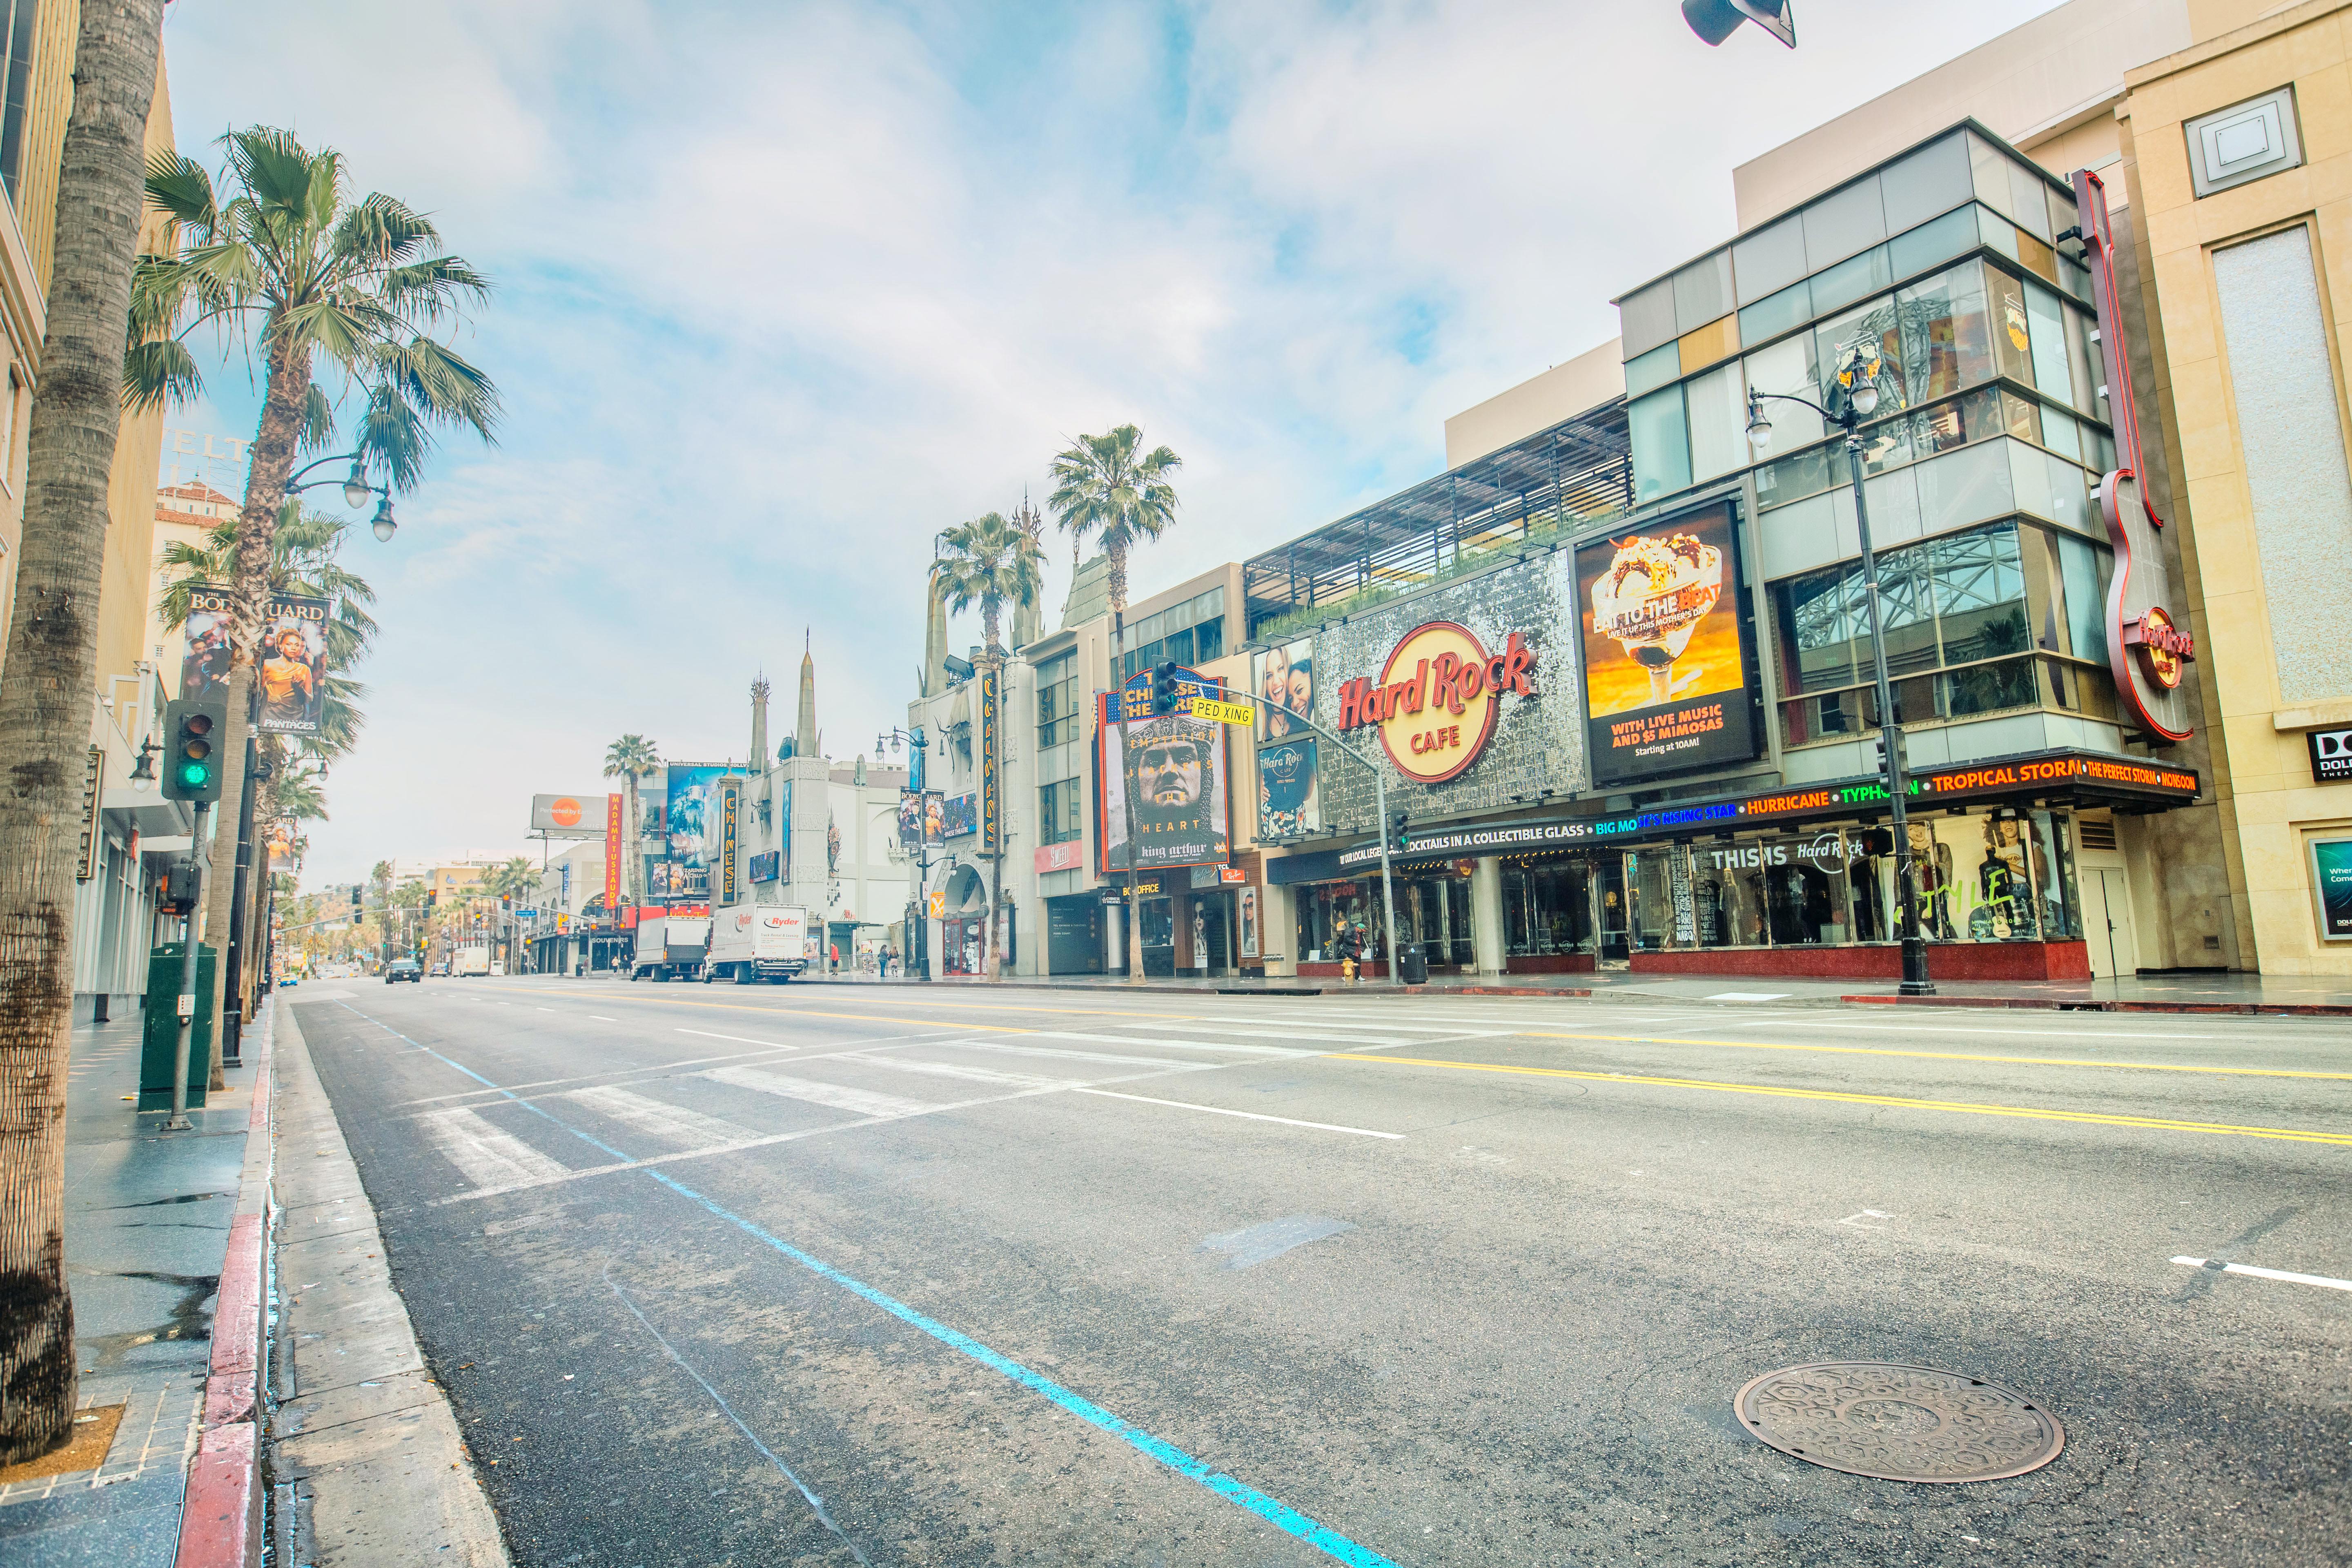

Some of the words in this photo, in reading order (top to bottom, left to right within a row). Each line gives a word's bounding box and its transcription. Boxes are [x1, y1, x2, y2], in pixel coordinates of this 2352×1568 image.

[1593, 613, 1619, 634] EAT
[1621, 607, 1644, 625] TO
[1646, 595, 1677, 619] THE
[1679, 583, 1722, 610] BEAT
[1607, 628, 1621, 639] LIVE
[1621, 627, 1628, 635] IT
[1629, 625, 1638, 634] UP
[1639, 621, 1655, 631] THIS
[1656, 610, 1692, 627] MOTHER'S
[1693, 607, 1708, 617] DAY
[1338, 658, 1430, 731] Hard
[1432, 631, 1539, 715] Rock
[1198, 702, 1219, 717] PED
[1224, 707, 1250, 722] XING
[1611, 719, 1645, 735] WITH
[1648, 713, 1675, 728] LIVE
[1679, 704, 1722, 723] MUSIC
[263, 719, 316, 730] PANTAGES
[1613, 733, 1640, 748] AND
[1643, 730, 1655, 744] $5
[1659, 717, 1723, 739] MIMOSAS
[1130, 730, 1216, 748] EMPTATION
[1410, 725, 1461, 754] CAFE
[1635, 746, 1665, 756] Starting
[1666, 742, 1674, 751] at
[1675, 737, 1699, 748] 10AM!
[1263, 755, 1285, 769] Hard
[2087, 761, 2103, 778] THE
[2103, 763, 2133, 782] PERFECT
[2133, 767, 2157, 785] STORM
[1933, 767, 2017, 793] TROPICAL
[2020, 760, 2082, 781] STORM
[2162, 775, 2196, 791] MONSOON
[1154, 792, 1185, 803] THE
[1748, 792, 1829, 815] HURRICANE
[611, 796, 619, 842] MADAME
[955, 826, 969, 835] THEATRE
[969, 824, 977, 833] IMA
[1143, 820, 1199, 833] HEART
[1596, 822, 1616, 835] BIG
[1663, 808, 1704, 825] RISING
[1705, 804, 1736, 820] STAR
[725, 797, 735, 893] CHINESE
[1142, 845, 1166, 858] king
[1169, 843, 1207, 857] arthur
[1345, 853, 1353, 863] OUR
[1352, 849, 1367, 862] LOCAL
[1405, 837, 1449, 852] OCKTAILS
[1451, 835, 1462, 846] IN
[1464, 835, 1472, 845] A
[1473, 828, 1543, 844] COLLECTIBLE
[1545, 825, 1584, 838] GLASS
[1711, 848, 1760, 869] THIS
[1764, 846, 1787, 866] IS
[1797, 843, 1829, 858] Hard
[1832, 840, 1864, 858] Rck
[1051, 845, 1070, 868] SWEET!
[1137, 884, 1159, 894] OFFICE
[739, 913, 751, 928] Ryder
[772, 918, 799, 926] Ryder
